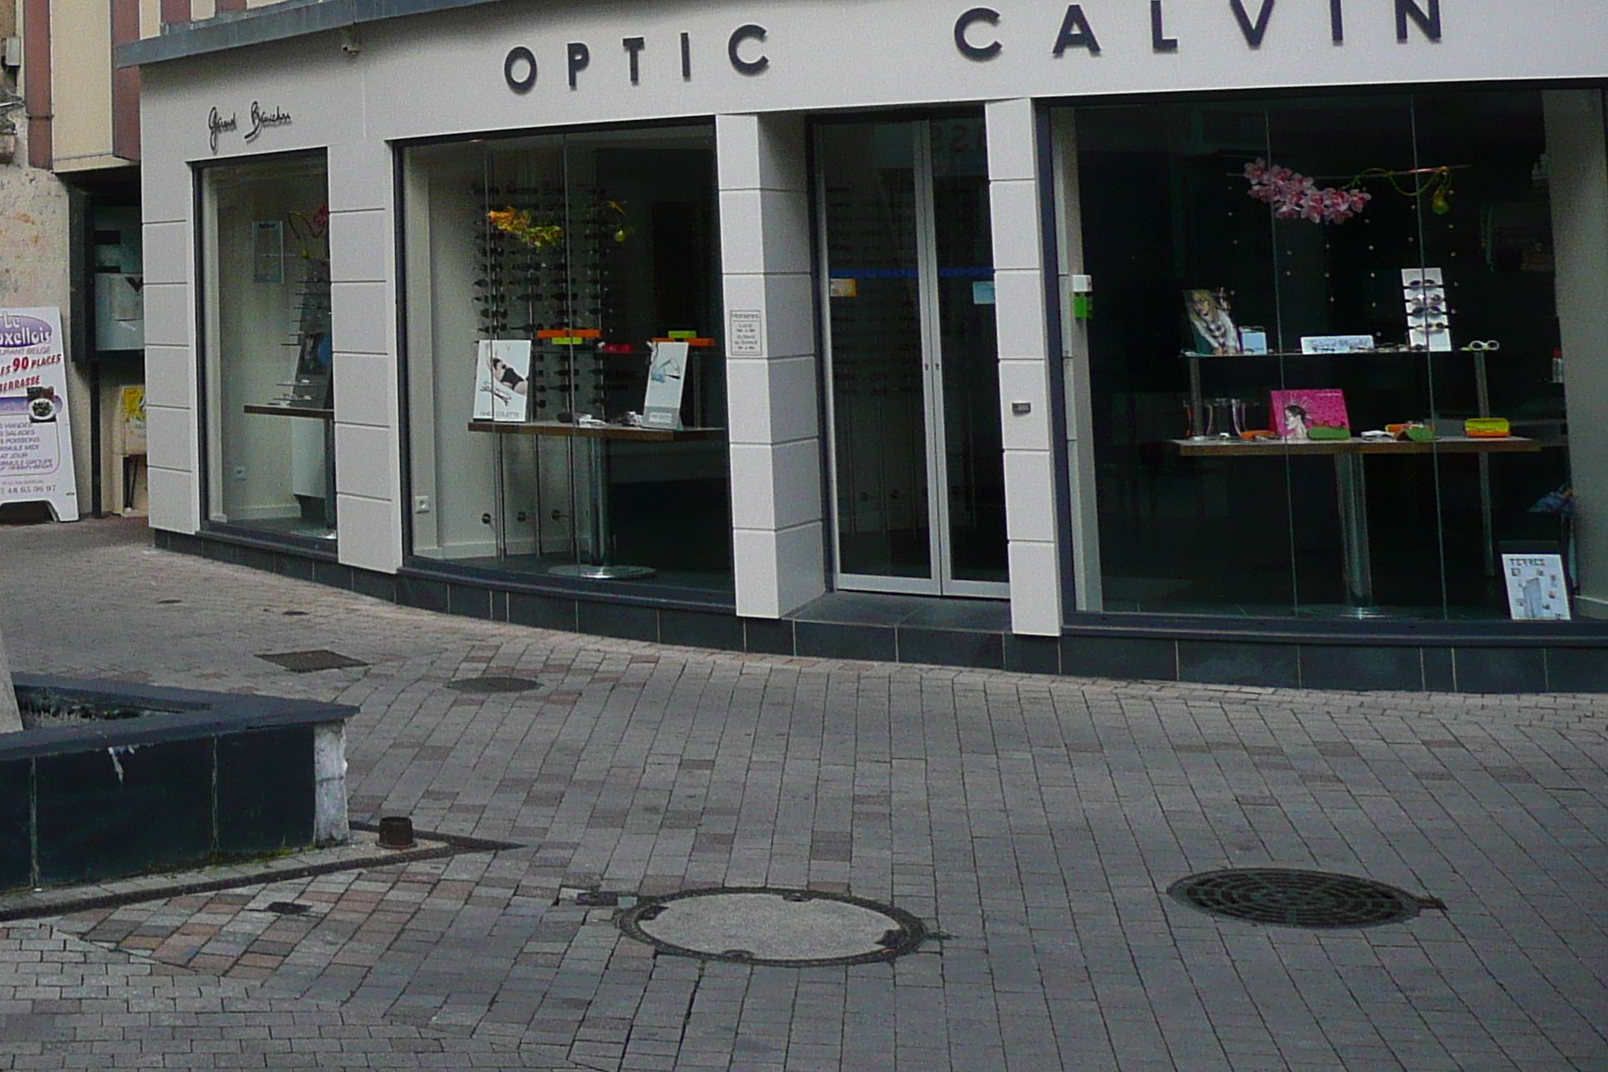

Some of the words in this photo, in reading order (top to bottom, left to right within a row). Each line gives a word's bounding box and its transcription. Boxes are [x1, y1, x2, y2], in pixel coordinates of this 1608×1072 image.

[504, 23, 770, 94] OPTIC
[3, 311, 20, 328] Le
[12, 356, 30, 372] 90
[32, 353, 62, 368] PLACES
[0, 376, 41, 392] TERRASSE
